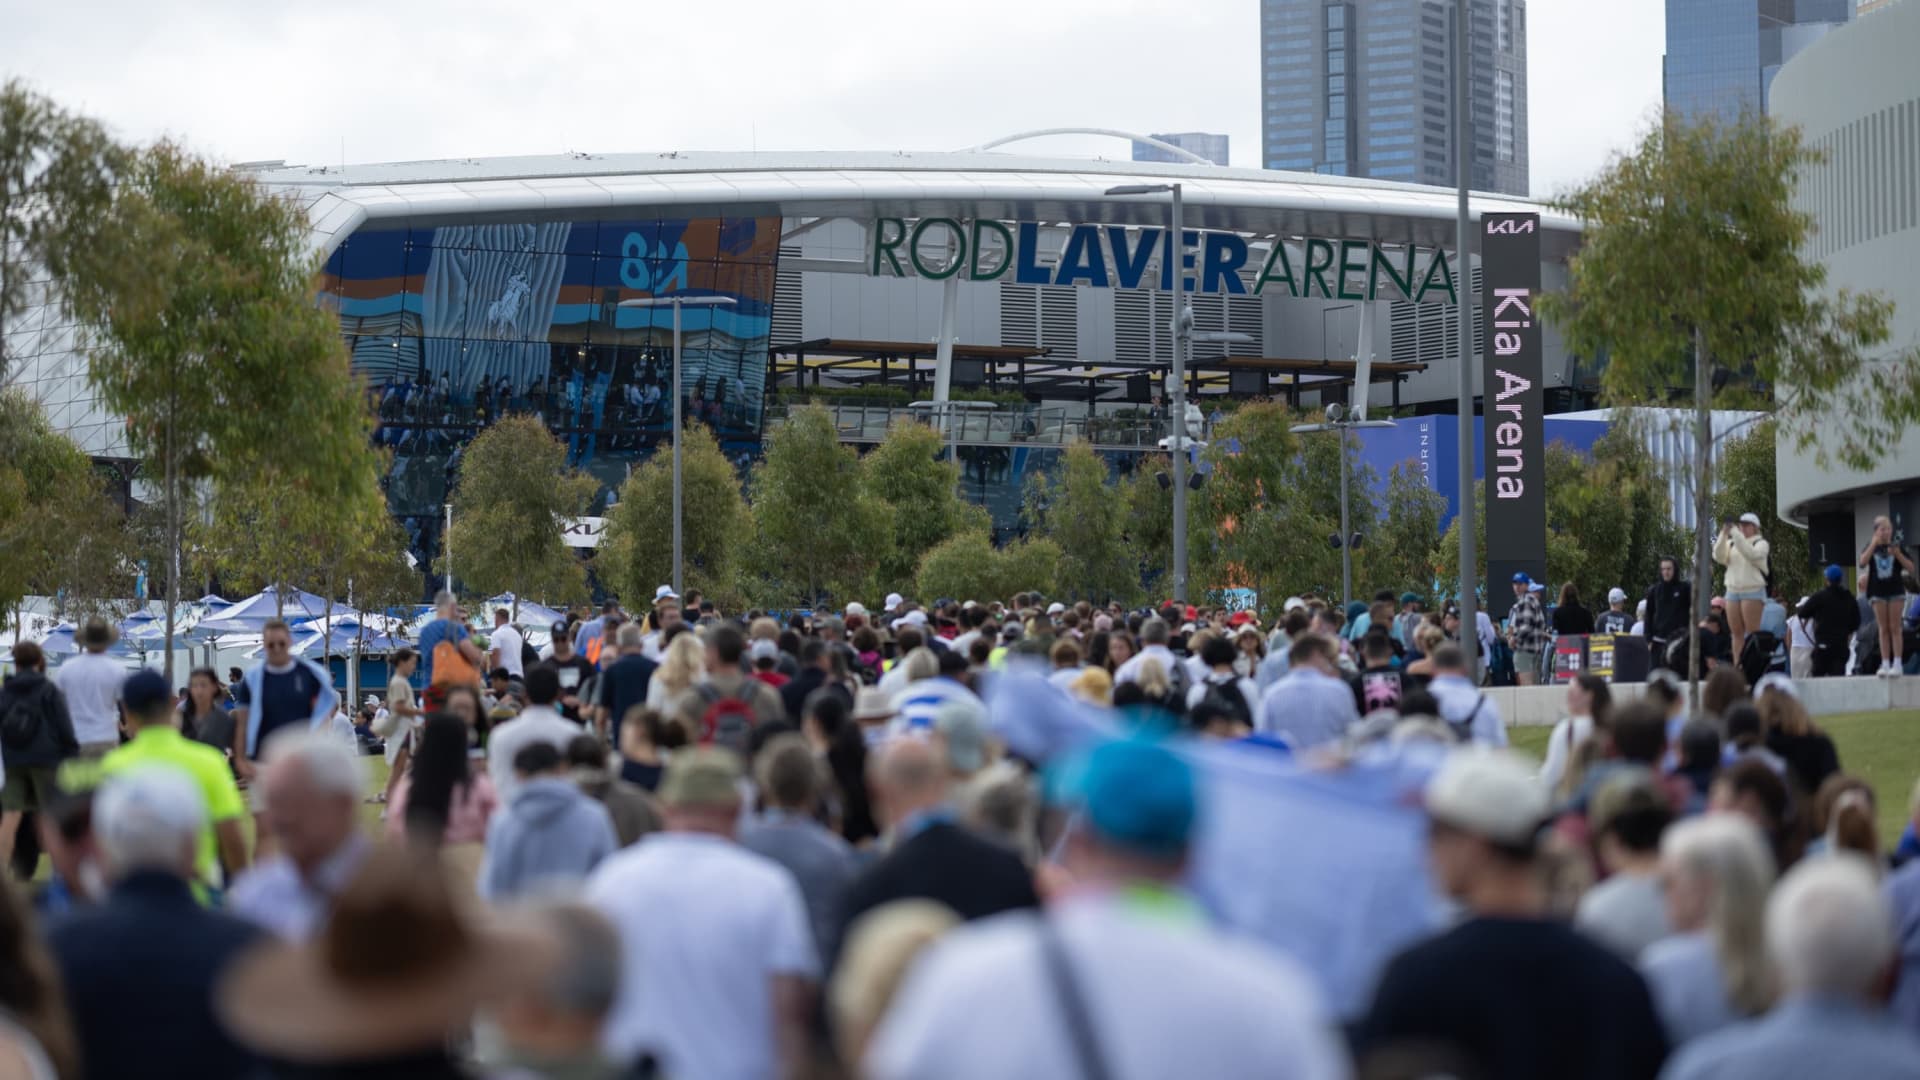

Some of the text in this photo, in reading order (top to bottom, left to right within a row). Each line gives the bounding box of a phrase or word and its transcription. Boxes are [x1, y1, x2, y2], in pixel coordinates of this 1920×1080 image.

[1420, 423, 1429, 488] OURNE
[1493, 287, 1532, 499] Kia Arena
